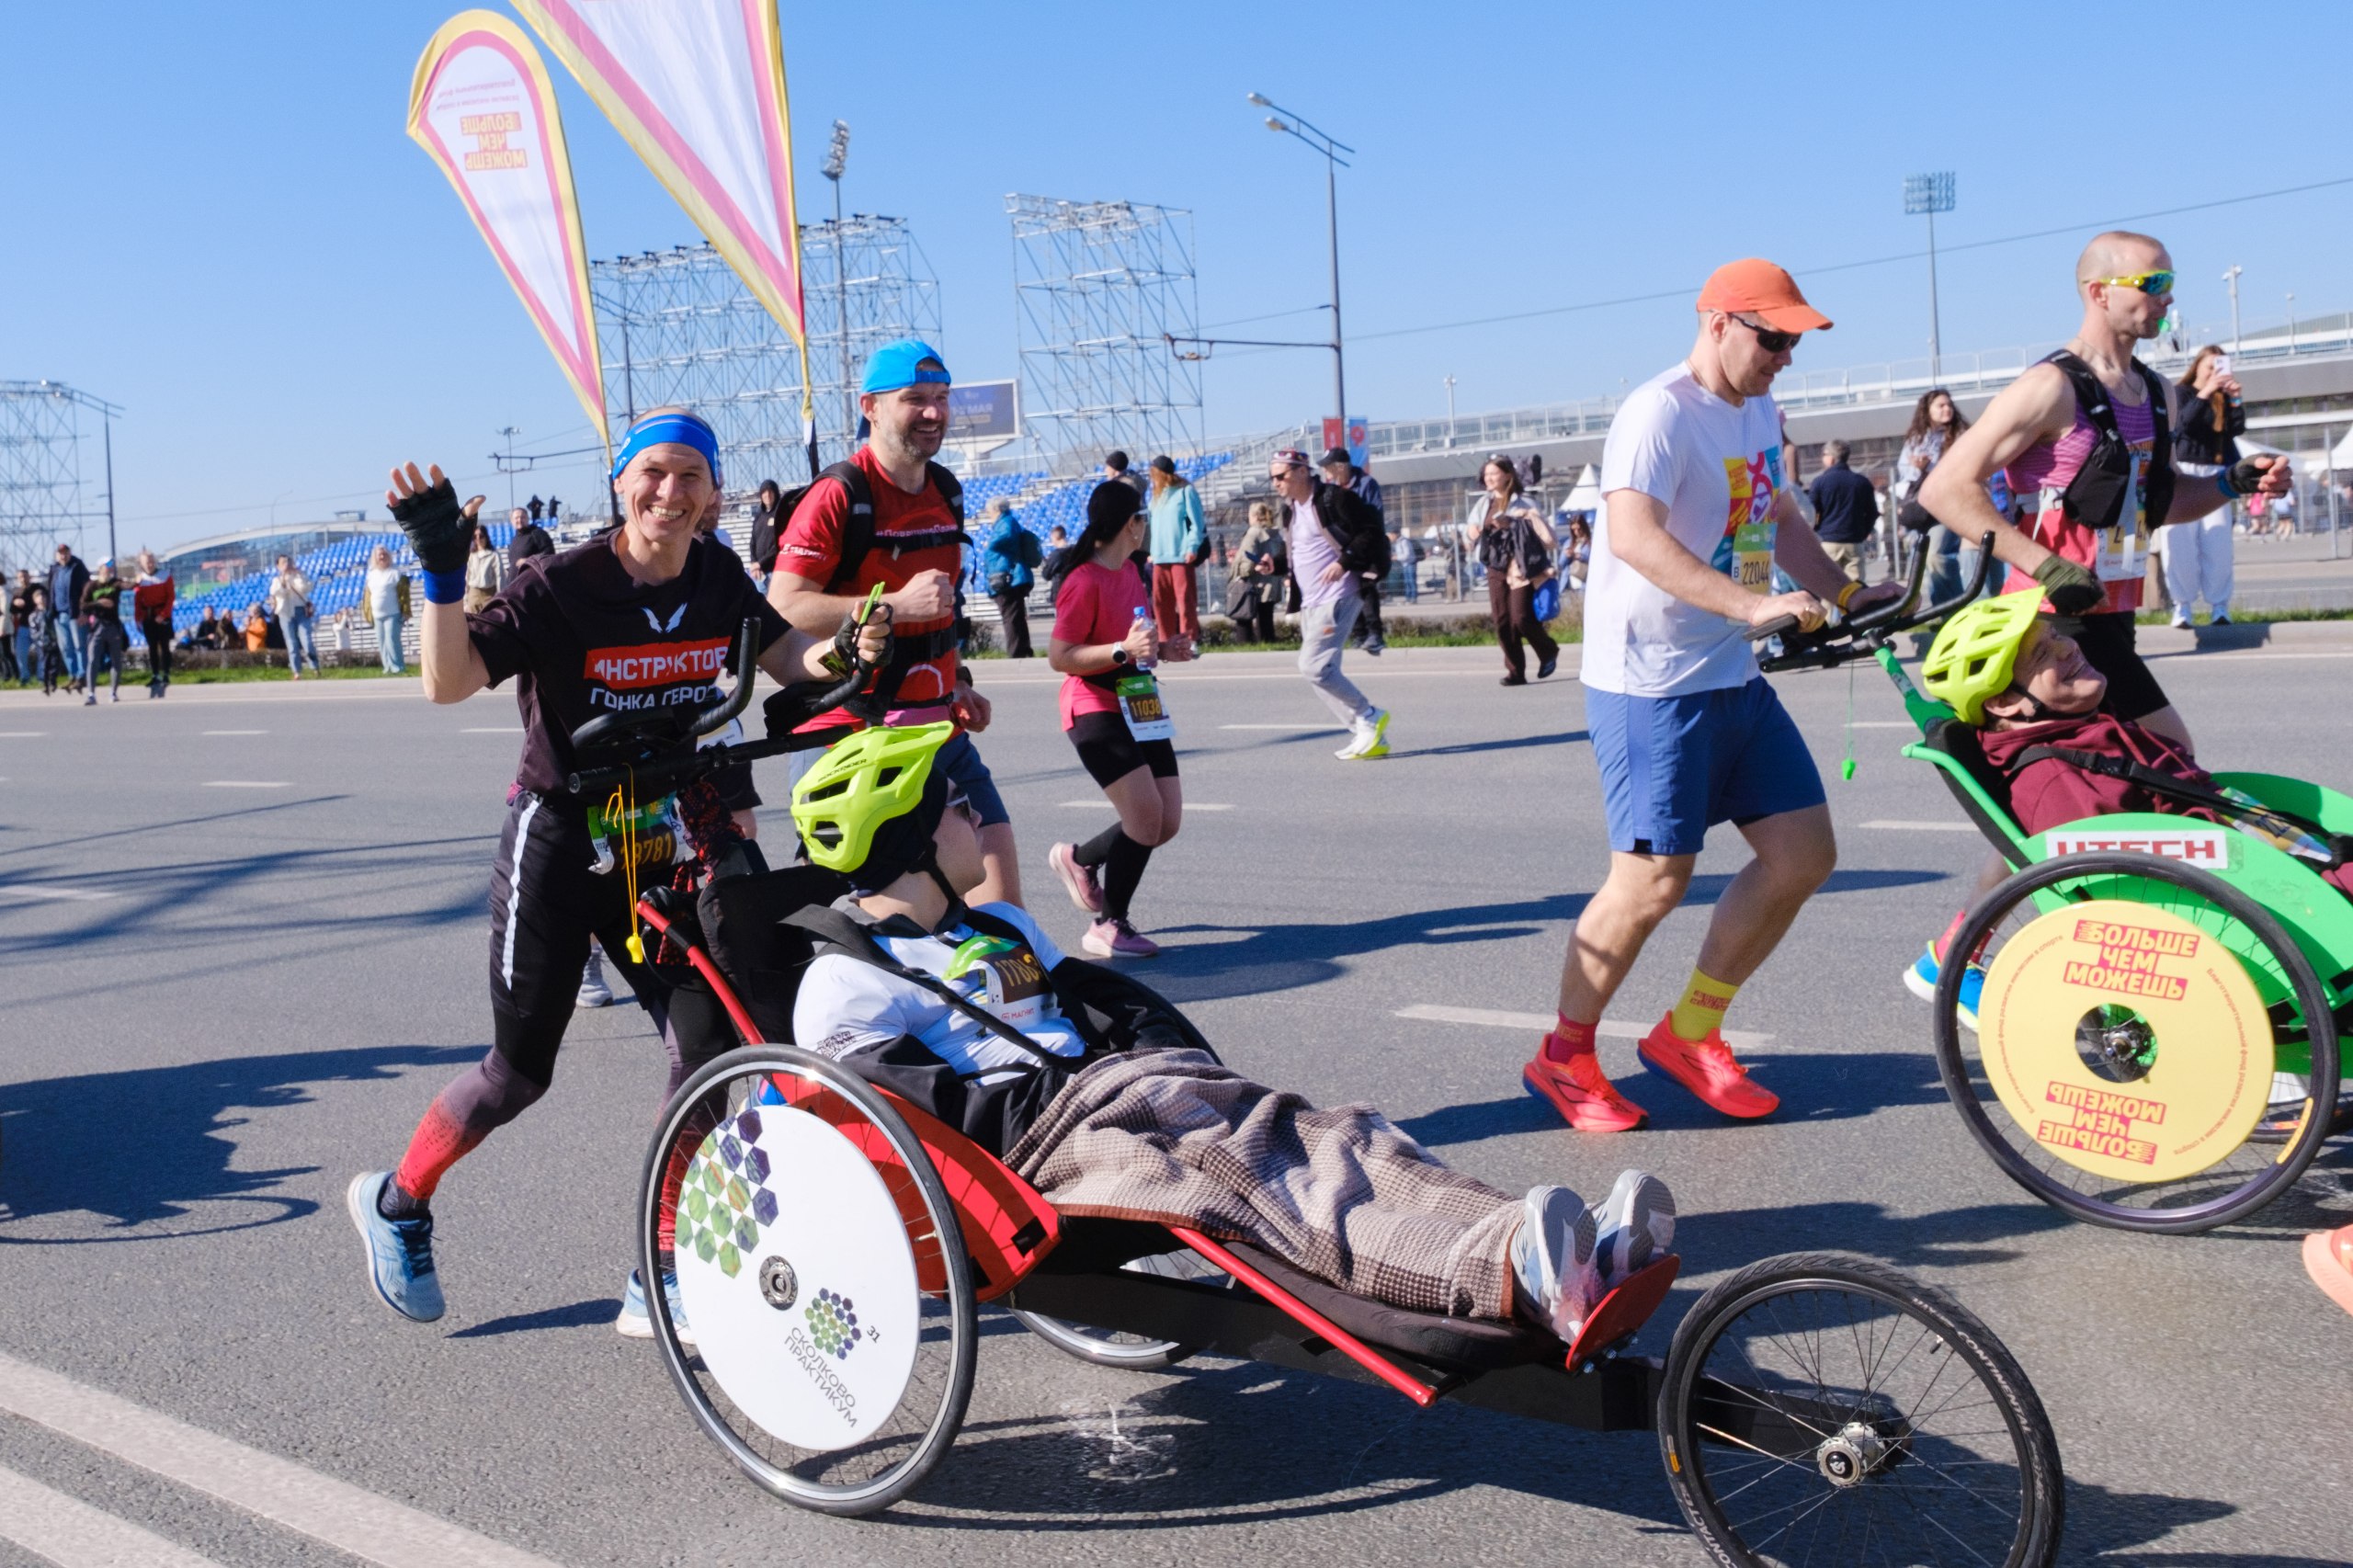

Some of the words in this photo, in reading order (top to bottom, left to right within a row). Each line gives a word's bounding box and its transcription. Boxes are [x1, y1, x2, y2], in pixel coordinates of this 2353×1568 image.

[590, 687, 655, 710] ГОНКА
[662, 686, 713, 705] ГЕРО
[1131, 699, 1162, 717] 11038
[2076, 920, 2199, 957] БОЛЬШЕ
[2102, 947, 2157, 973] ЧЕМ
[2065, 962, 2184, 999] МОЖЕШЬ
[2048, 1084, 2164, 1122] МОЖЕШЬ
[2075, 1108, 2127, 1137] ЧЕМ
[2038, 1121, 2154, 1164] БОЛЬШЕ
[866, 1325, 881, 1344] 31
[784, 1335, 858, 1427] ПРАКТИКУМ
[791, 1326, 856, 1408] СКОЛКОВО
[1957, 1330, 2031, 1433] CONTINENTAL
